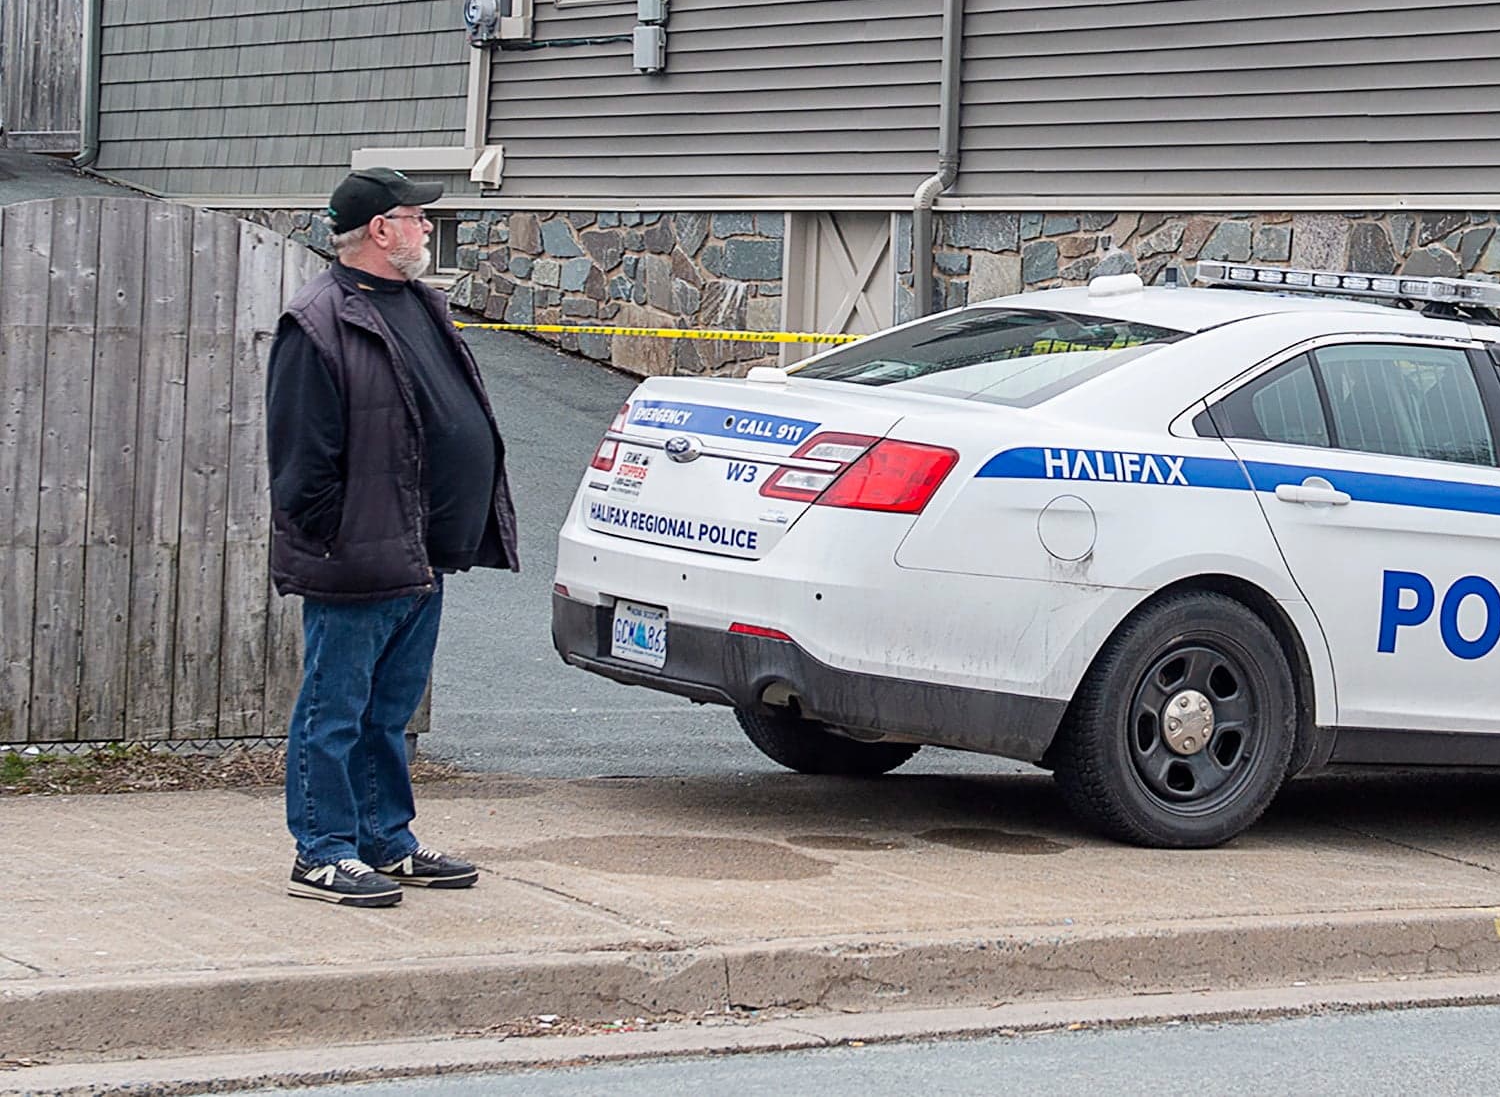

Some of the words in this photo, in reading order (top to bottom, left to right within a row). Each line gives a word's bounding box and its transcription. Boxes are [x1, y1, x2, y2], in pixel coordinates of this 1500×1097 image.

[633, 407, 693, 427] EMERGENCY
[736, 419, 773, 438] CALL
[776, 424, 803, 442] 911
[725, 462, 758, 483] W3
[1044, 449, 1189, 487] HALIFAX
[590, 502, 629, 531] HALIFAX
[630, 512, 694, 540] REGIONAL
[699, 524, 758, 550] POLICE
